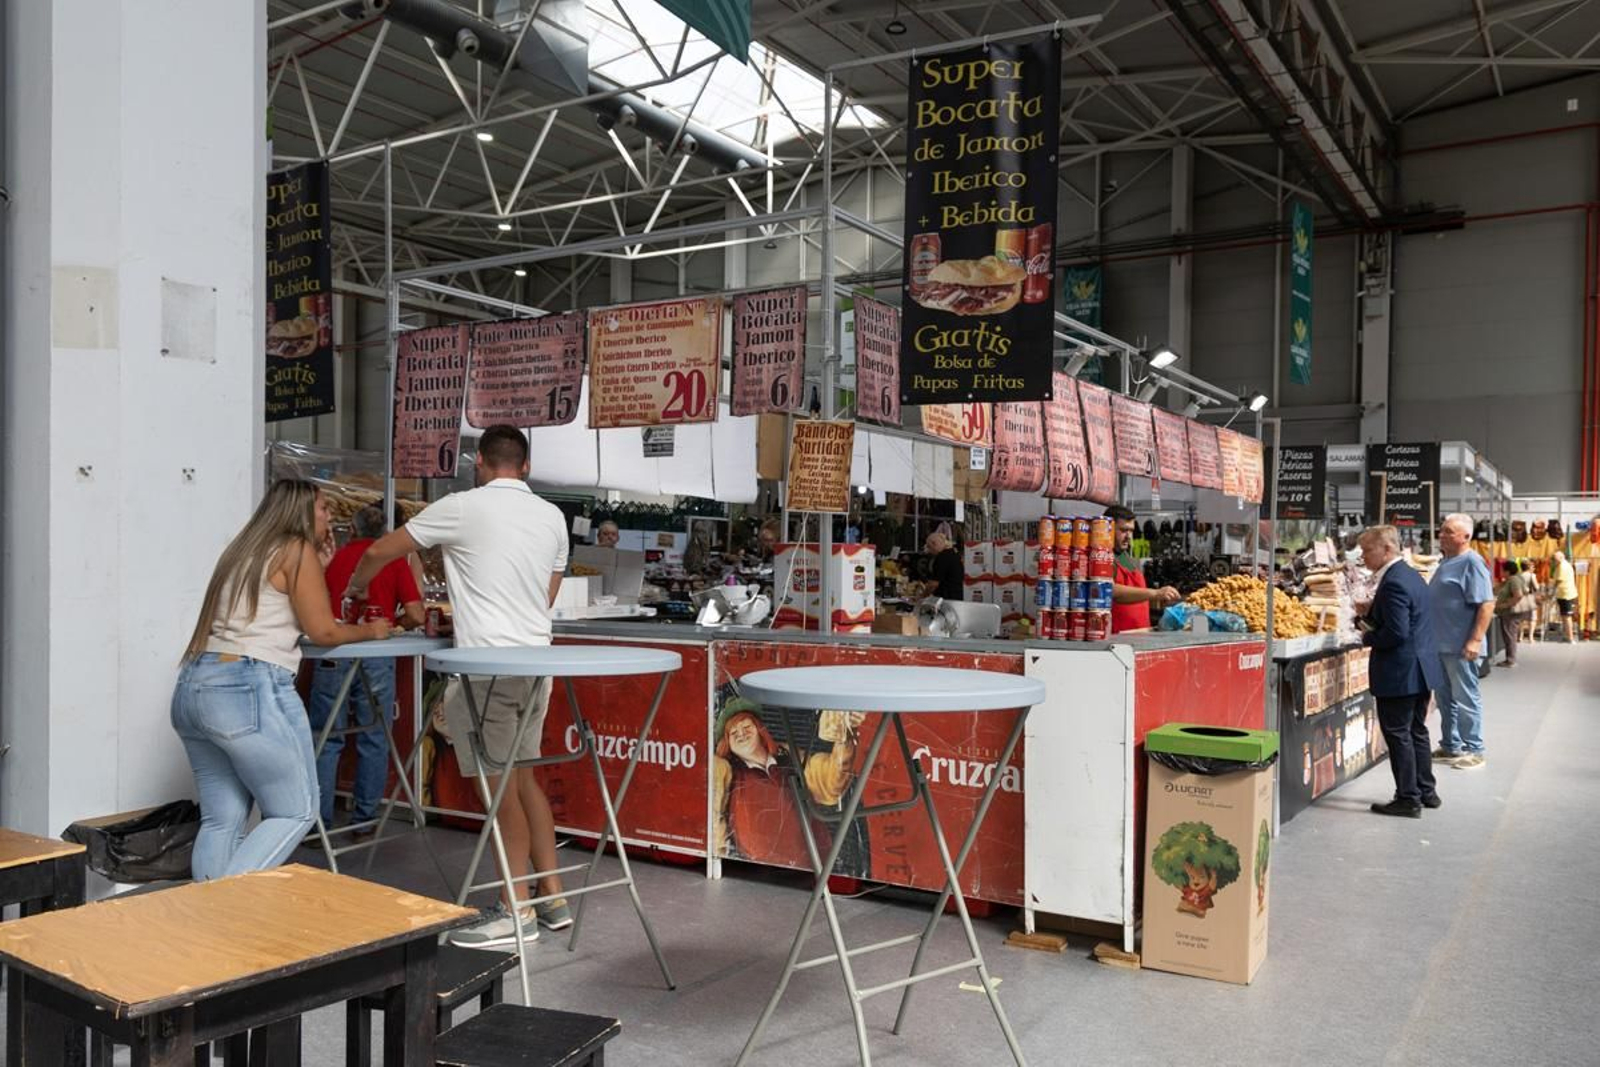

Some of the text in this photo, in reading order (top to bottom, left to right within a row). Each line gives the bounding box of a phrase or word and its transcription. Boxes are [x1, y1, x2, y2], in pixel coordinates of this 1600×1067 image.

[922, 58, 1024, 91] Super
[915, 91, 1043, 130] Bocata
[914, 132, 1045, 163] de Jamon
[266, 178, 301, 205] uper
[931, 165, 1027, 195] Iberico
[266, 200, 320, 230] ocata
[941, 199, 1036, 230] Bebida
[275, 276, 320, 300] Bebida
[747, 294, 798, 313] Super
[862, 303, 893, 326] Super
[741, 310, 801, 330] Bocata
[859, 316, 897, 342] Bocata
[411, 334, 459, 352] Super
[636, 335, 667, 345] Iberico
[744, 328, 794, 348] Jamon
[862, 334, 893, 357] Jamon
[914, 321, 1011, 356] Gratis
[407, 355, 463, 373] Bocata
[644, 348, 672, 359] Iberico
[743, 349, 796, 366] Iberico
[862, 354, 894, 376] Iberico
[934, 353, 997, 370] Bolsa de
[407, 374, 462, 394] Jamon
[661, 369, 707, 419] 20
[771, 373, 788, 407] 6
[914, 374, 1025, 393] Papas Fritas
[404, 394, 463, 412] Iberico
[546, 385, 573, 421] 15
[881, 386, 891, 417] 6
[796, 423, 852, 440] Bandejas
[438, 440, 454, 473] 6
[798, 439, 846, 456] Surtidas
[1285, 449, 1313, 460] Piezas
[1066, 463, 1084, 493] 20
[1277, 470, 1312, 481] Caseras
[1386, 485, 1419, 495] Caseras
[565, 724, 696, 772] Cuzcampo
